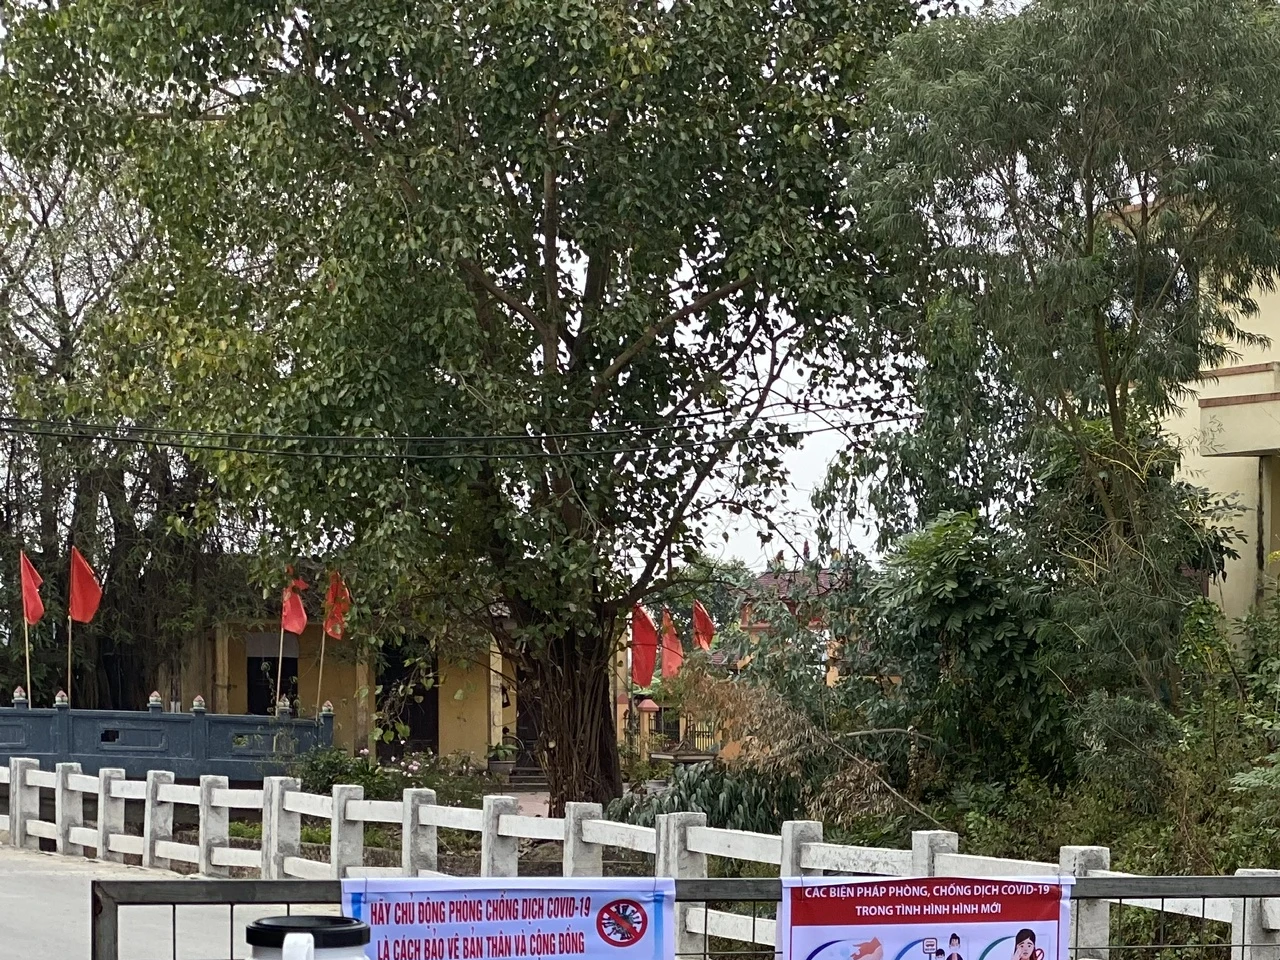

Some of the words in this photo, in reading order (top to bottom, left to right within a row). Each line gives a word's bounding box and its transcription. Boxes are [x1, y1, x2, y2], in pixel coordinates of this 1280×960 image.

[804, 885, 827, 898] CÁC
[829, 885, 855, 900] BIỆN
[857, 885, 886, 897] PHÁP
[889, 884, 931, 898] PHÒNG,
[933, 883, 971, 896] CHỐNG
[974, 885, 999, 898] DỊCH
[1001, 884, 1050, 895] COVID-19
[371, 899, 391, 925] HÃY
[394, 892, 415, 924] CHỦ
[418, 897, 446, 929] ĐỘNG
[449, 895, 482, 922] PHÒNG
[486, 891, 519, 920] CHỐNG
[521, 897, 544, 924] DỊCH
[547, 896, 591, 918] COVID-19
[855, 905, 893, 916] TRONG
[895, 903, 920, 915] TÌNH
[923, 902, 949, 915] HÌNH
[952, 902, 978, 914] HÌNH
[980, 902, 1001, 914] MỚI
[393, 935, 421, 960] CÁCH
[424, 928, 444, 960] BẢO
[463, 926, 483, 959] BẢN
[486, 930, 511, 958] THÂN
[514, 929, 527, 956] VÀ
[530, 929, 555, 960] CỘNG
[558, 924, 585, 954] ĐỒNG
